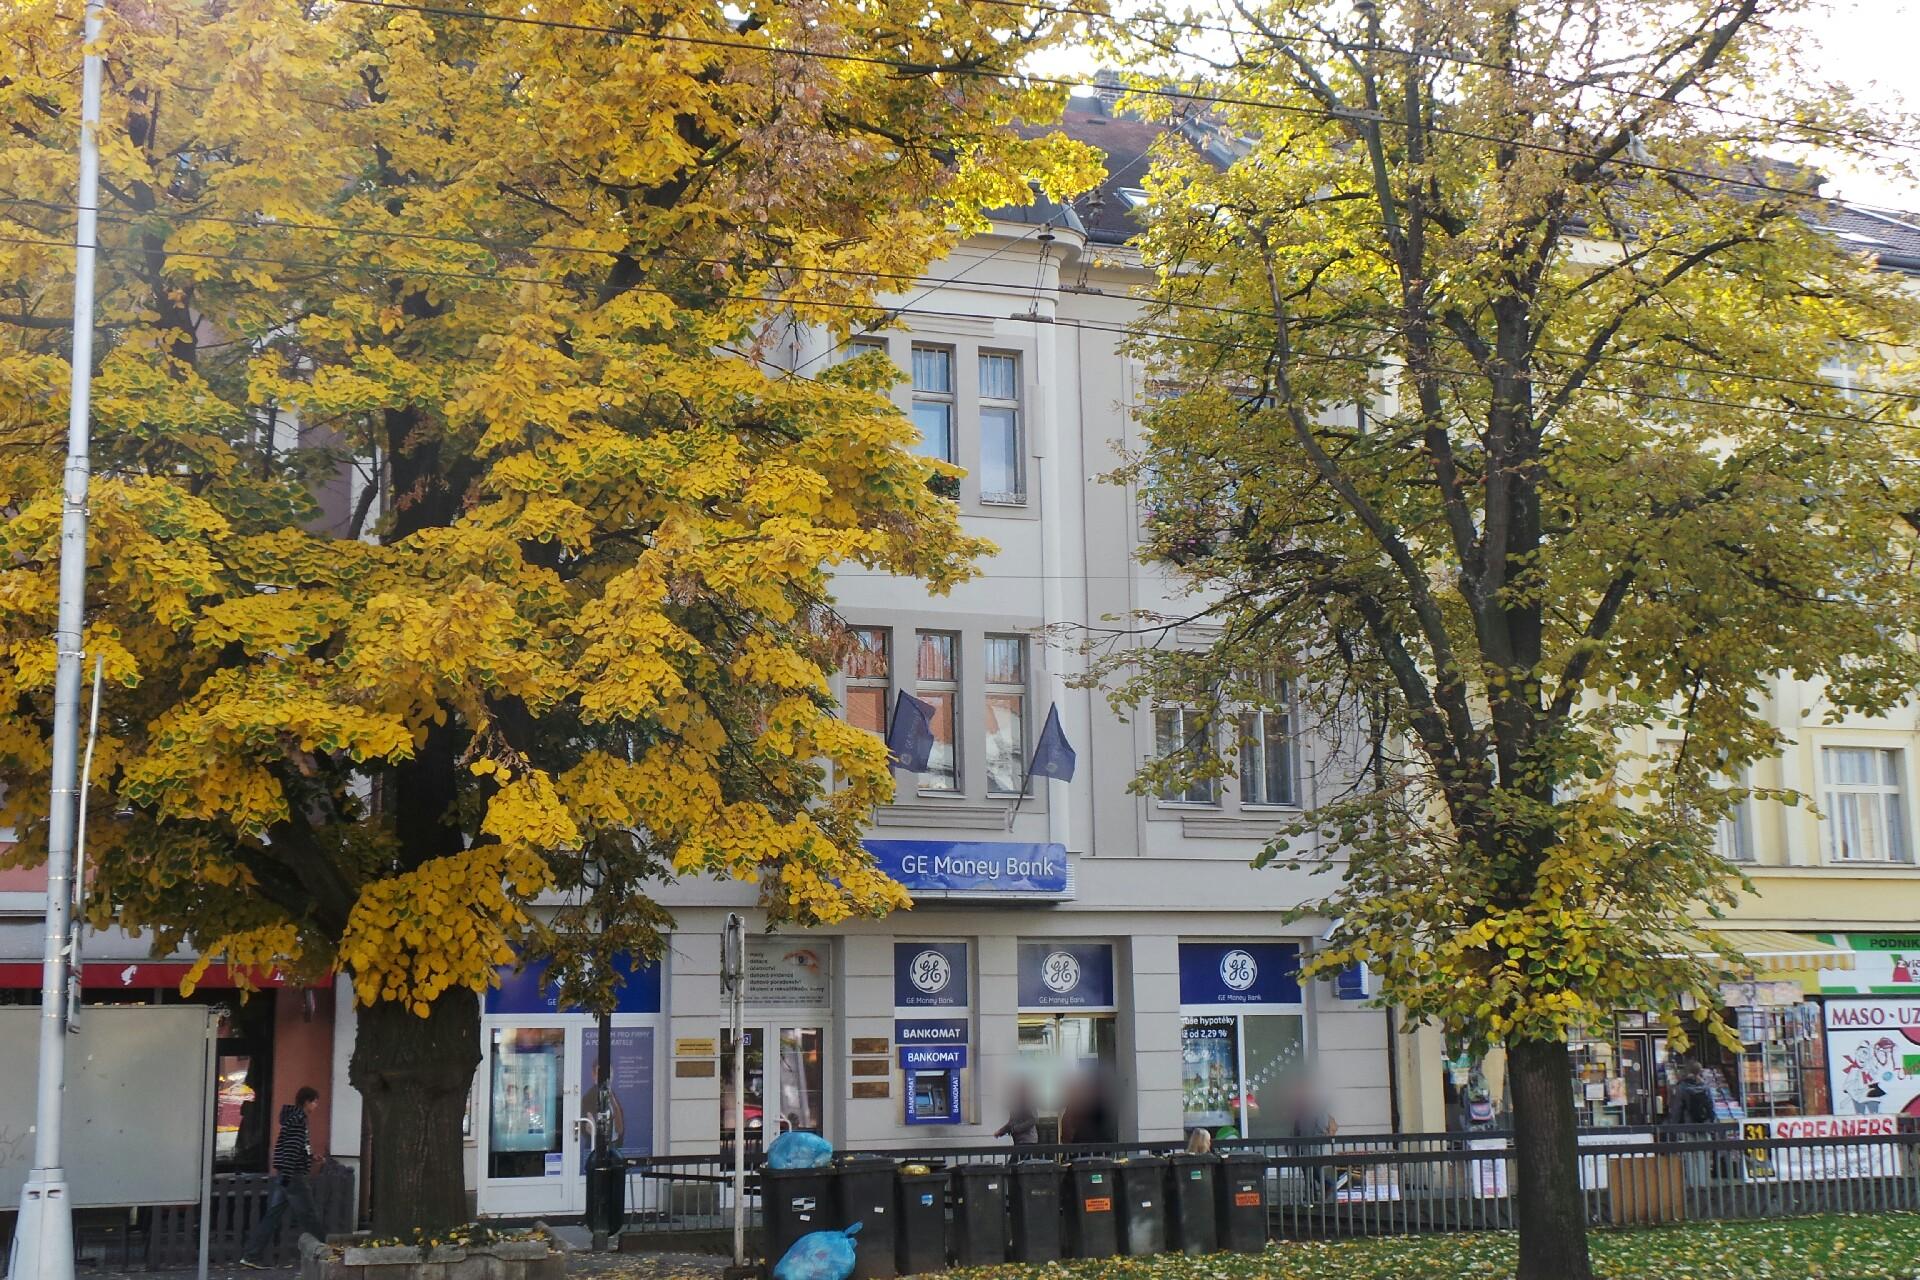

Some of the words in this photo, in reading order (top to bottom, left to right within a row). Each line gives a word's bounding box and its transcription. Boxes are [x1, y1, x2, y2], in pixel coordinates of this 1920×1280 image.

[902, 855, 928, 874] GE
[935, 856, 1000, 880] Money
[1006, 857, 1054, 876] Bank
[547, 998, 557, 1006] GE
[916, 997, 937, 1005] Money
[1039, 996, 1049, 1004] GE
[1049, 996, 1069, 1004] Money
[1227, 994, 1247, 1002] Money
[1199, 1016, 1235, 1026] hypotéky
[1832, 1007, 1885, 1026] MASO
[903, 1028, 961, 1039] BANKOMAT
[1190, 1029, 1199, 1038] od
[1200, 1029, 1217, 1039] 2,29
[1218, 1029, 1228, 1038] %
[907, 1052, 960, 1062] BANKOMAT
[1777, 1118, 1893, 1140] SCREAMERS
